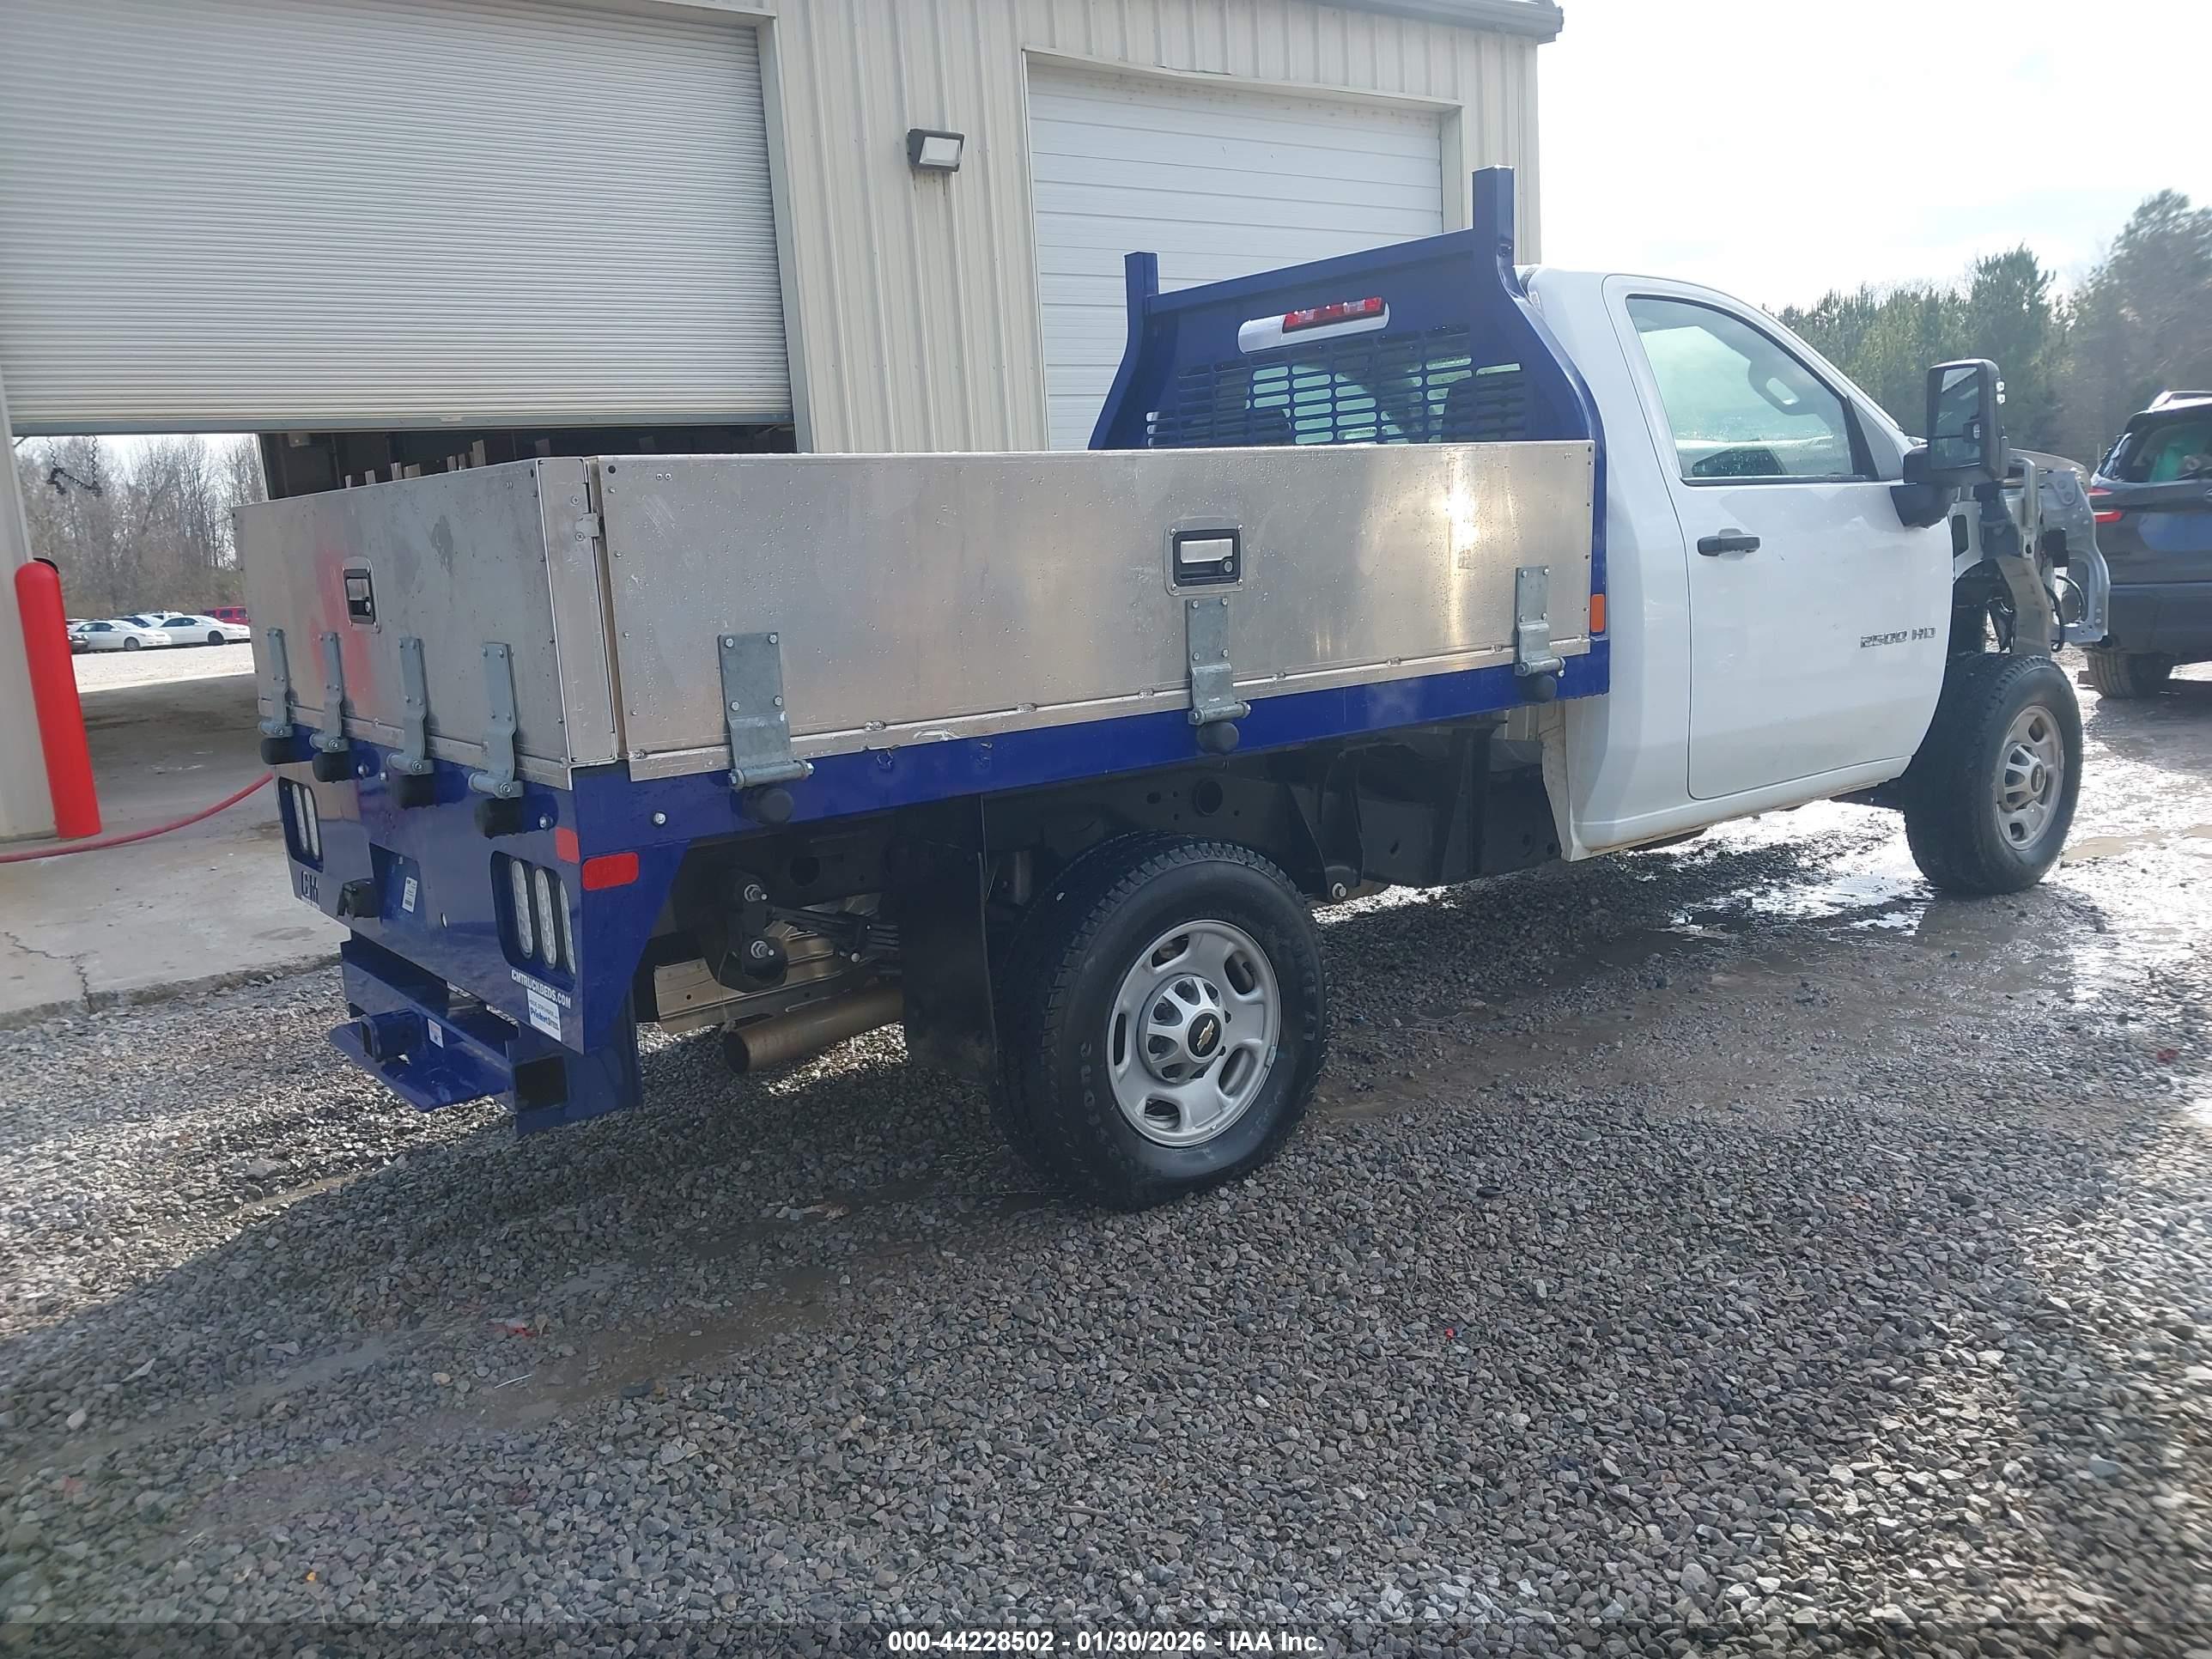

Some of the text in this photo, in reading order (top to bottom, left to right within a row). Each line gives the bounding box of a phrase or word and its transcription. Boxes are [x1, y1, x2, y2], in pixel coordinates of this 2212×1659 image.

[1860, 628, 1936, 647] 2500 HD
[511, 969, 571, 1009] CMTRUCKBEDS.COM
